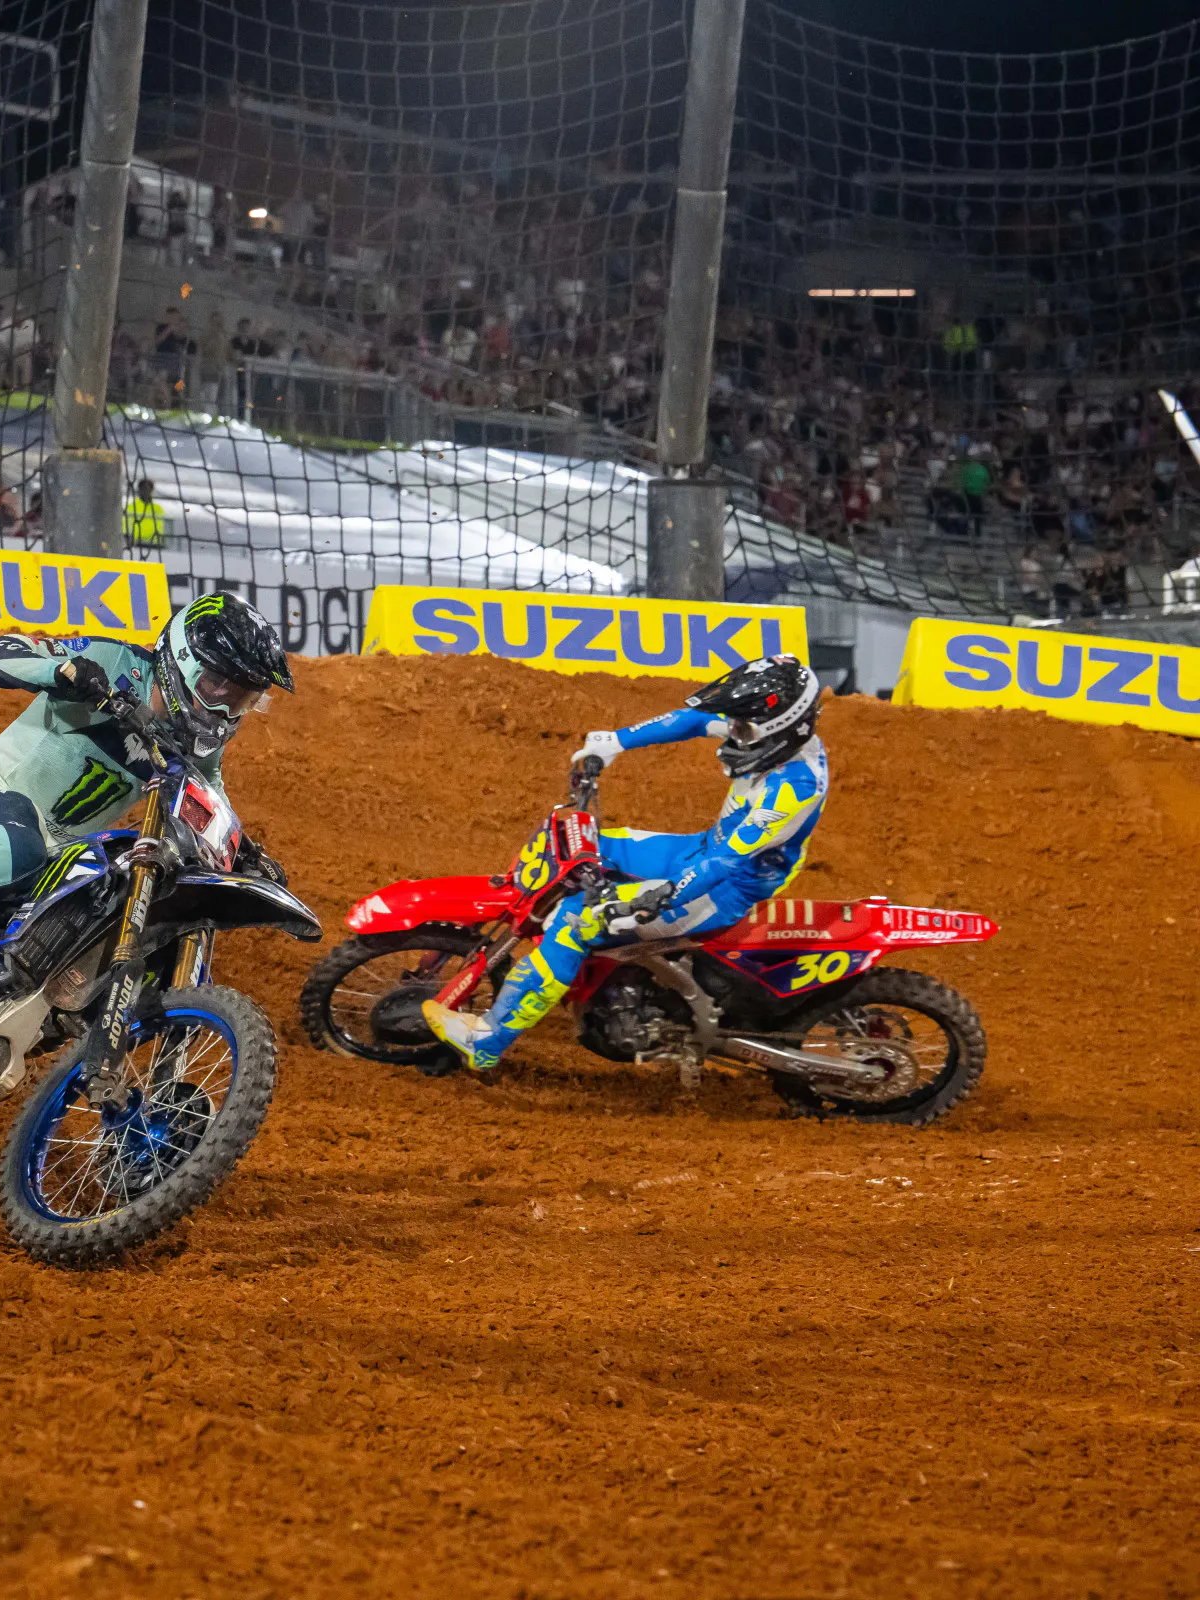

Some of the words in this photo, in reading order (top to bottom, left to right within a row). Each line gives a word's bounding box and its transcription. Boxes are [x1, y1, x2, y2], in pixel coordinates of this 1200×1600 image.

[412, 598, 784, 673] SUZUKI
[765, 698, 808, 732] OAKLEY
[520, 831, 550, 891] 30
[767, 930, 833, 940] HONDA
[889, 930, 958, 940] DUNLOP
[791, 951, 850, 990] 30
[106, 982, 119, 1011] BRAKING
[109, 974, 134, 1050] DUNLOP
